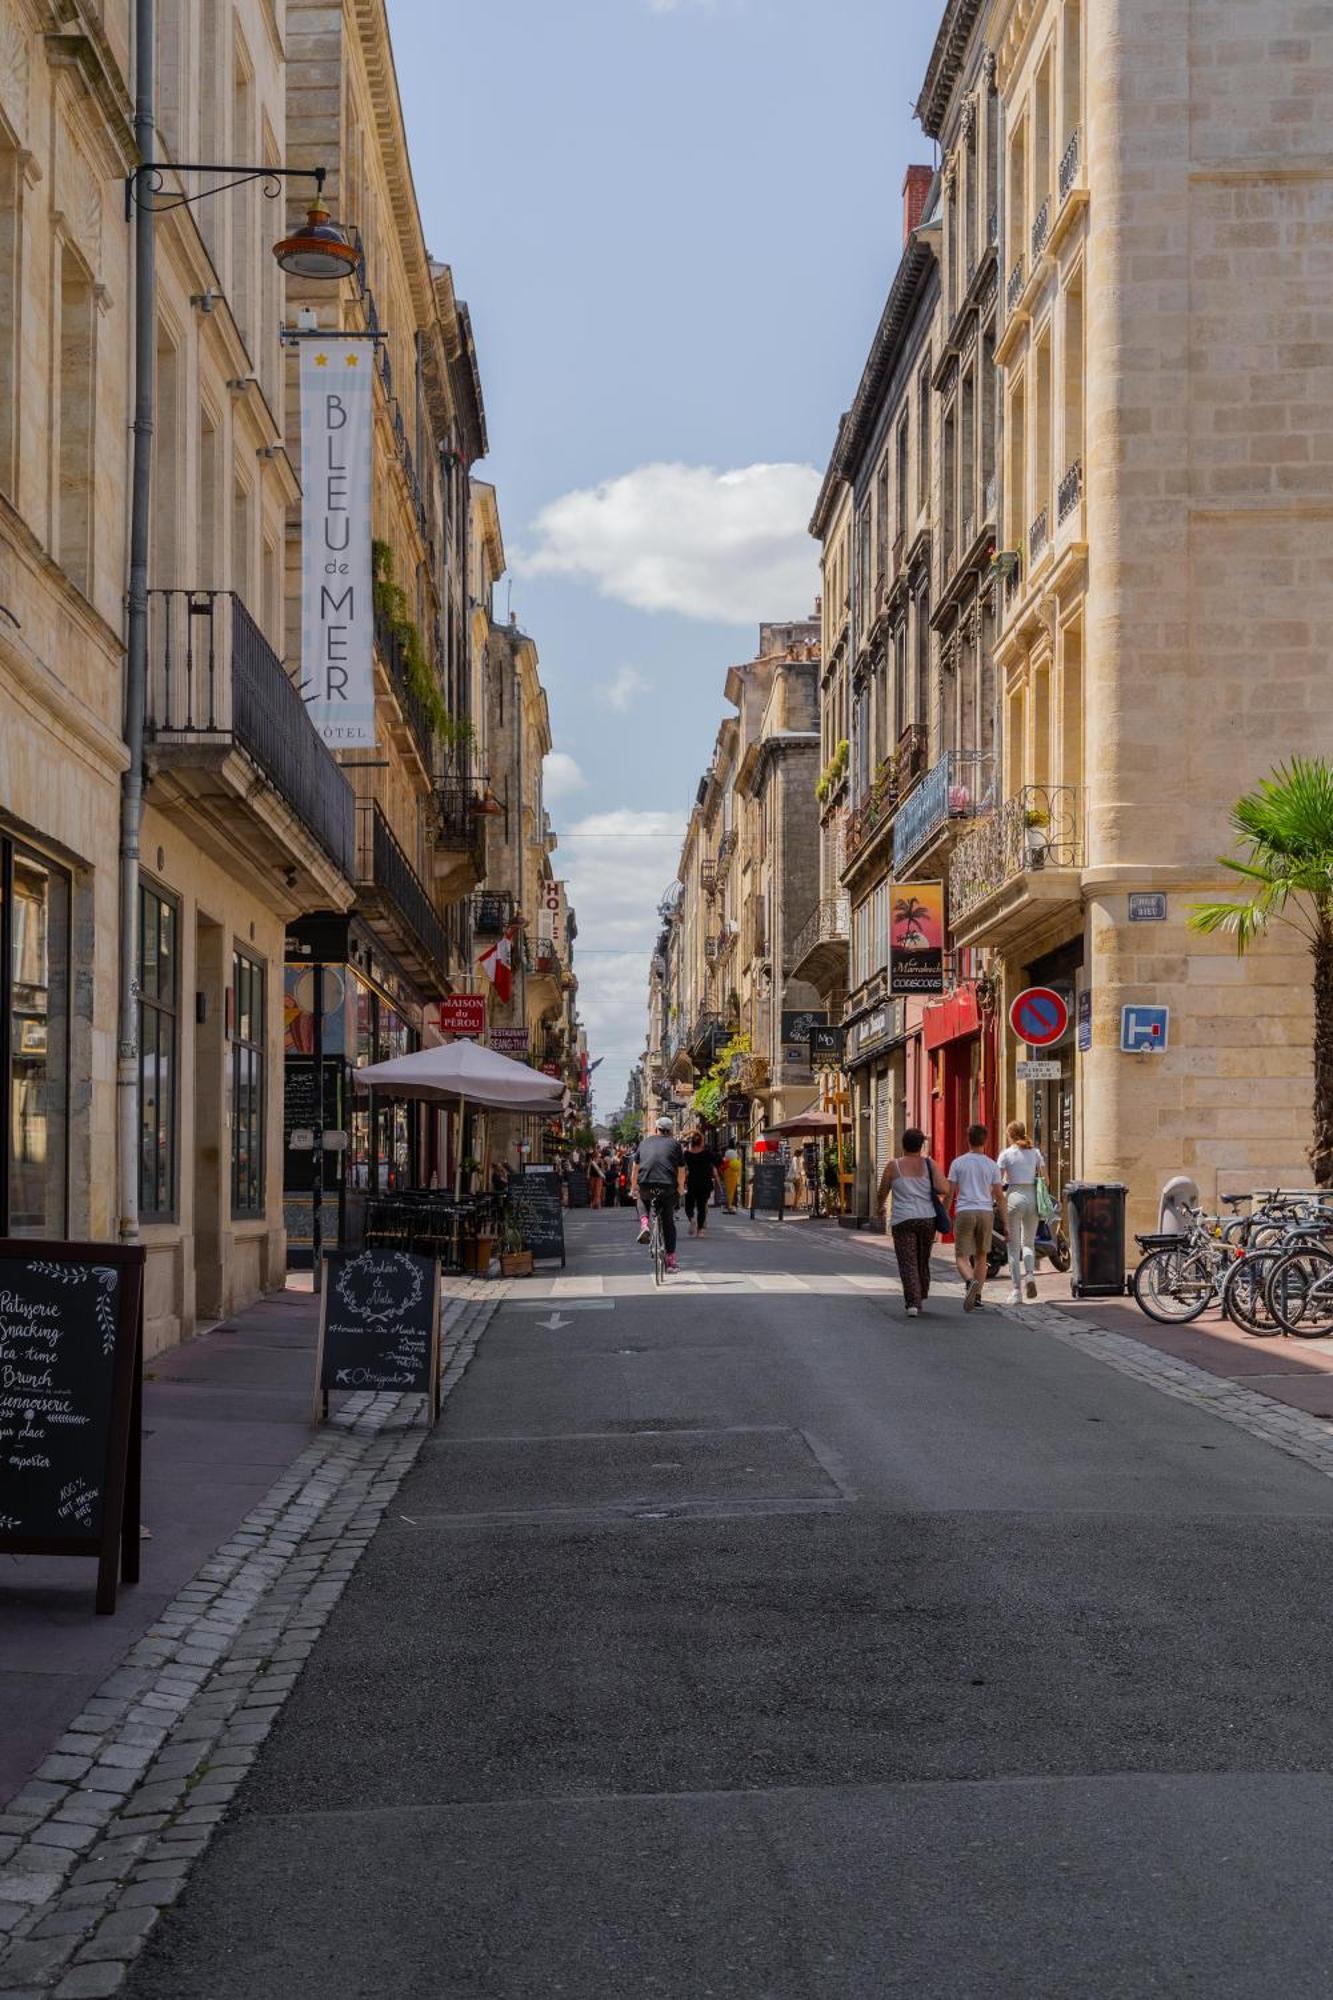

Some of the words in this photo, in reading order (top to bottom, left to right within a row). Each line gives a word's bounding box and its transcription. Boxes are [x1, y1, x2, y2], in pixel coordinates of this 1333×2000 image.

[325, 395, 350, 551] BLEU
[324, 558, 350, 575] de
[321, 585, 354, 700] MER
[316, 726, 366, 738] ÔTEL
[442, 999, 484, 1008] MAISON
[456, 1009, 468, 1018] du
[1, 1365, 53, 1387] Brunch
[0, 1393, 74, 1413] iennoiserie
[18, 1421, 45, 1440] place
